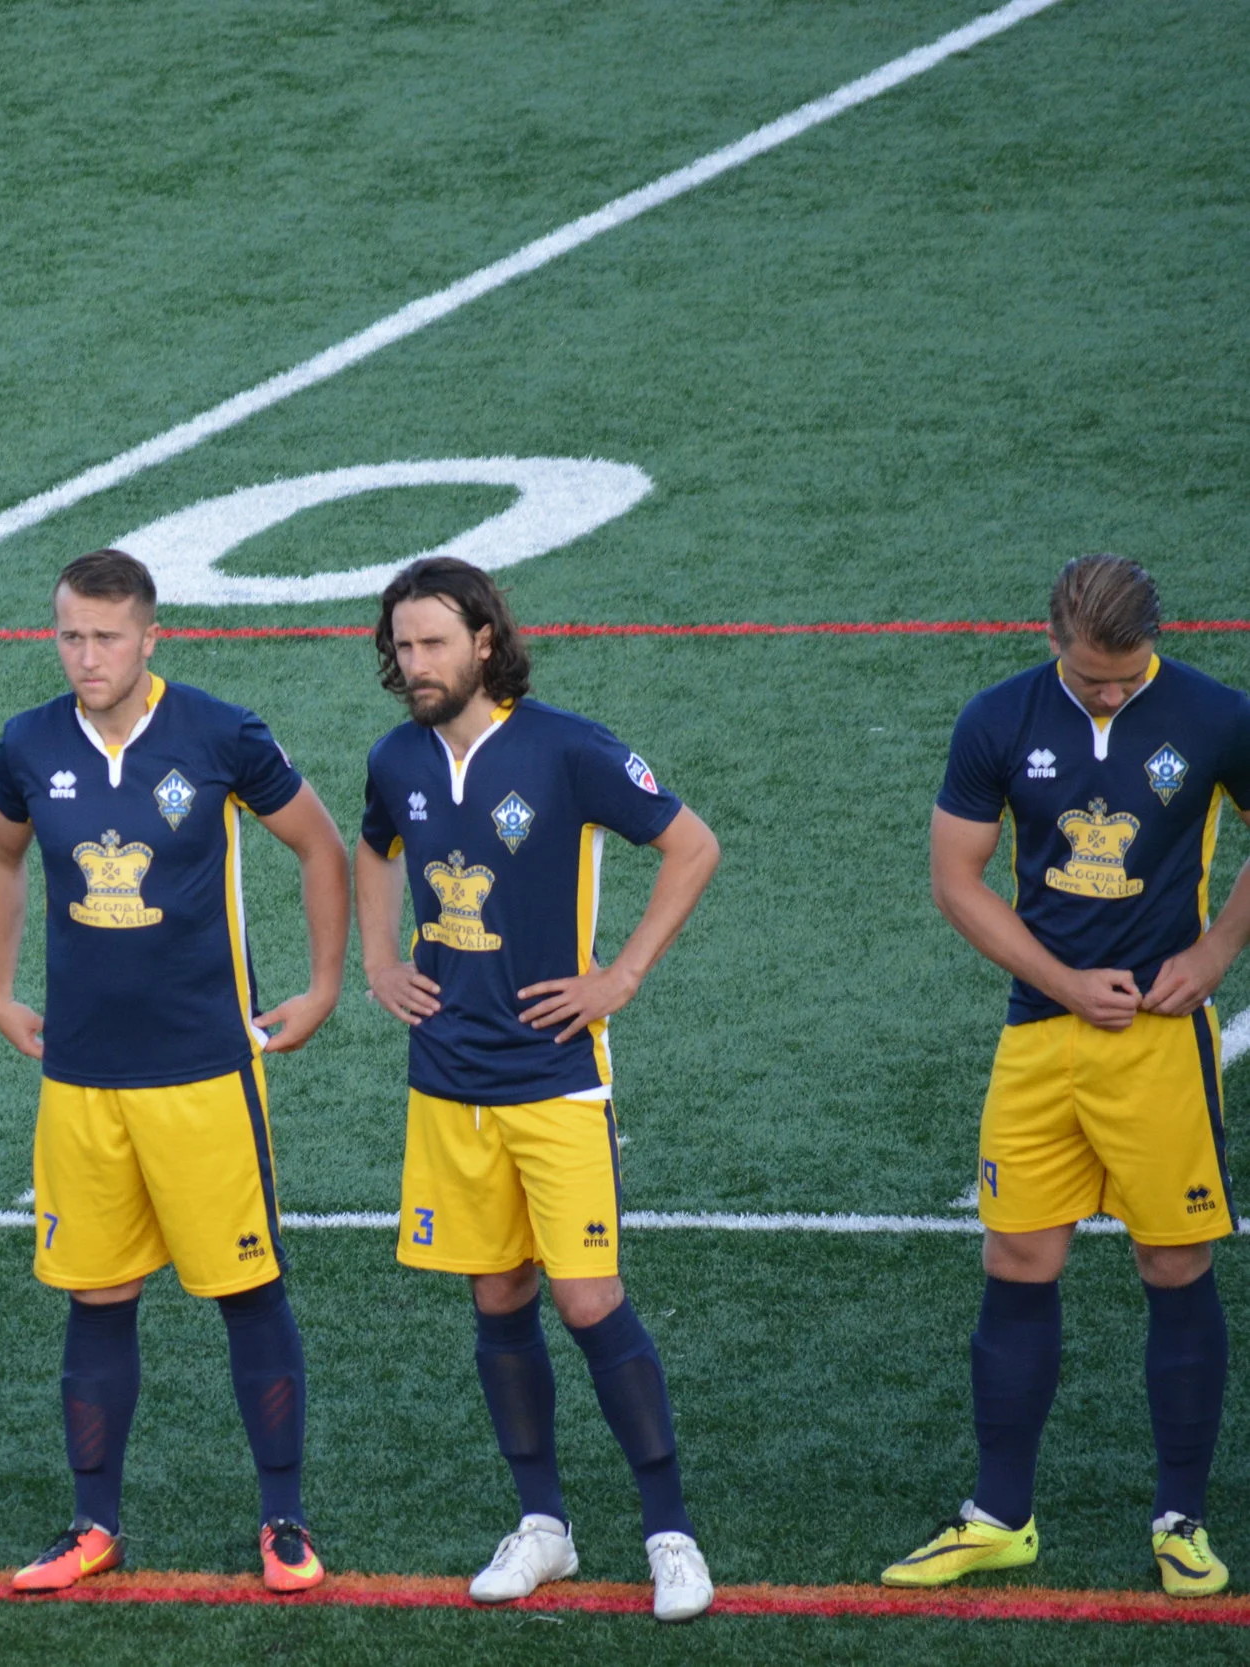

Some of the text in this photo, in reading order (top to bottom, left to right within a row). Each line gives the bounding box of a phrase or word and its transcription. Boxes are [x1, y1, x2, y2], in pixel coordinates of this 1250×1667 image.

[1048, 870, 1142, 896] Pierre Vallet
[1064, 861, 1126, 884] Cognac
[84, 896, 144, 914] Cognac
[110, 909, 161, 925] Vallet
[44, 1212, 58, 1249] 7
[413, 1207, 434, 1245] 3
